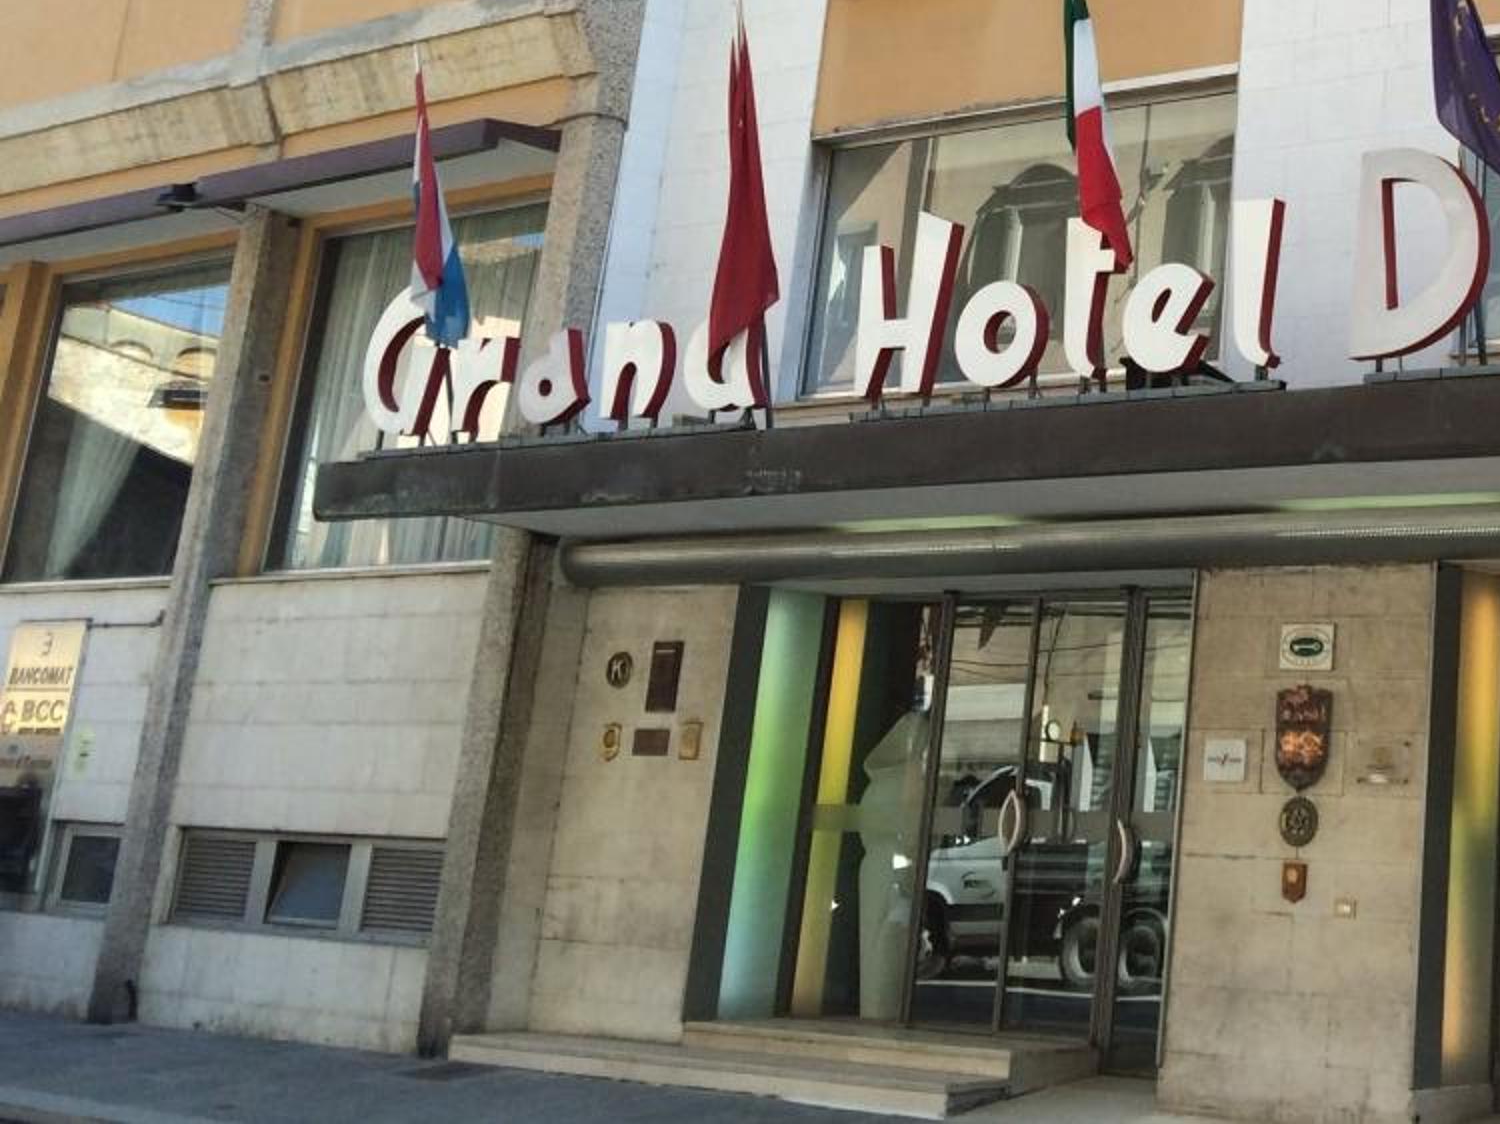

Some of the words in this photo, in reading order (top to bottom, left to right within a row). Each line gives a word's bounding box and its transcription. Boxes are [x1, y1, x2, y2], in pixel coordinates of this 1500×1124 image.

[853, 197, 1287, 402] Hotel
[9, 667, 73, 684] BANCOMAT
[20, 699, 65, 723] BCC
